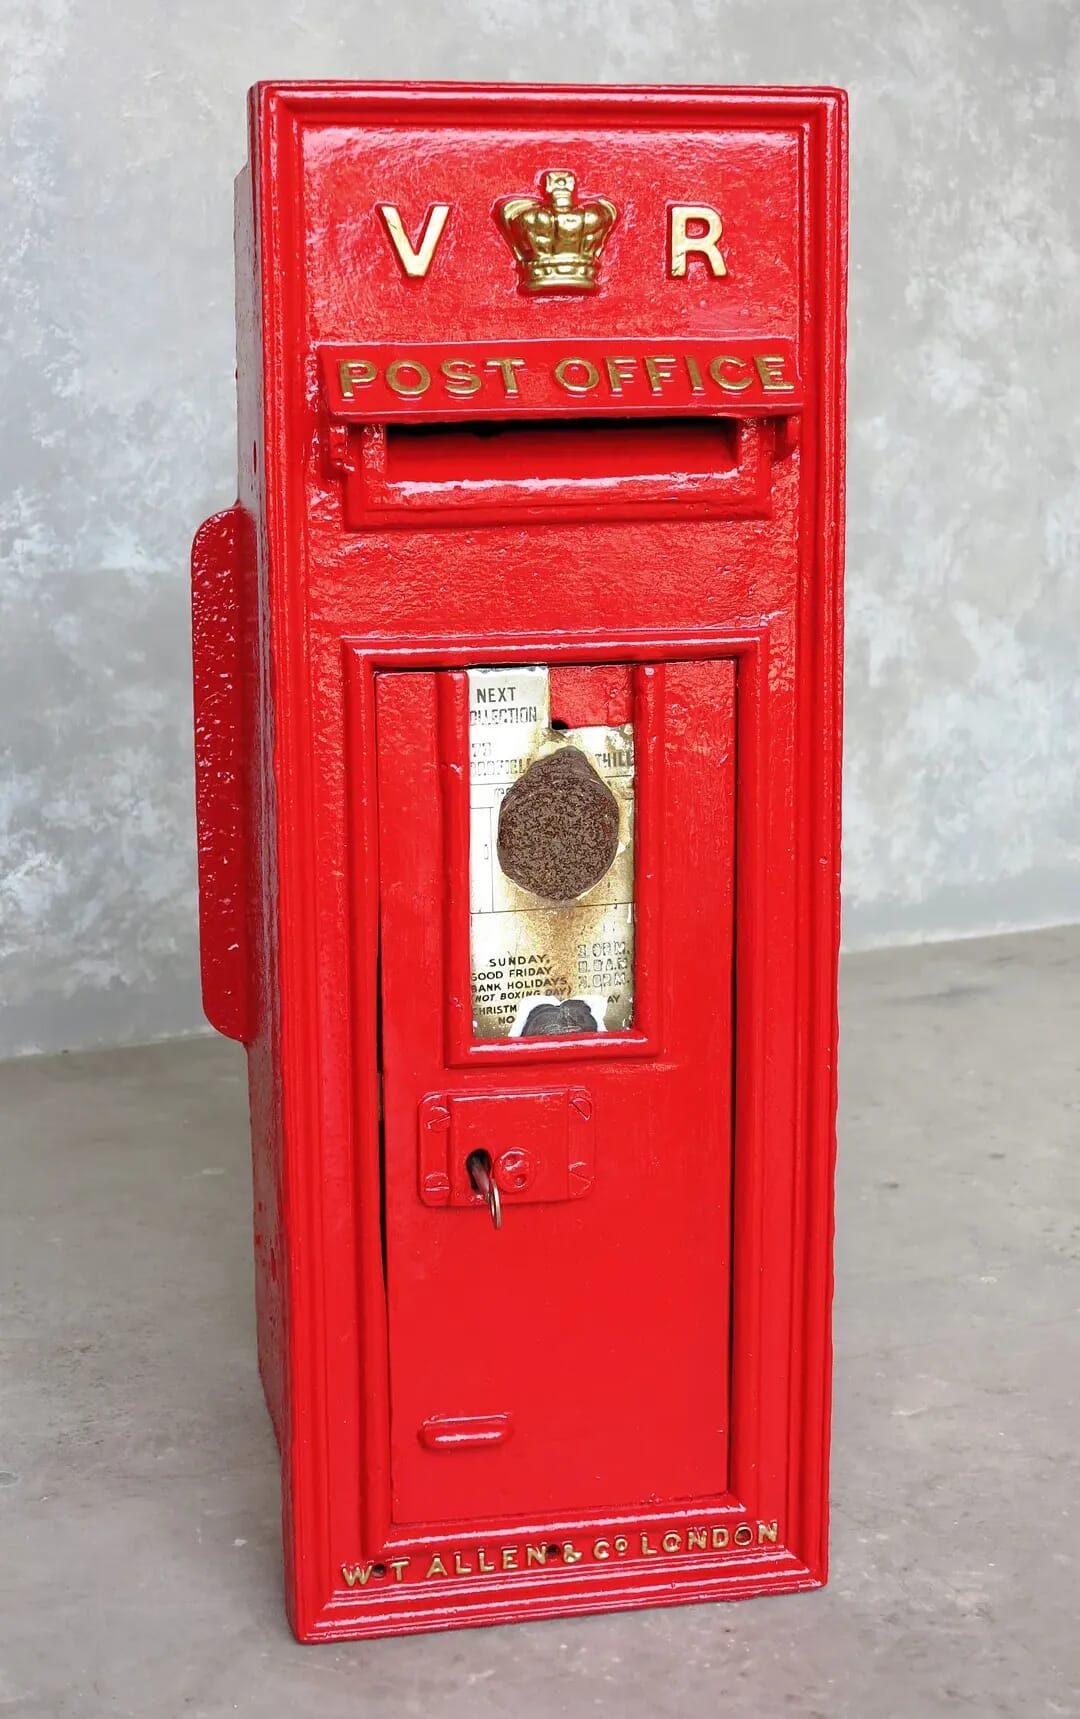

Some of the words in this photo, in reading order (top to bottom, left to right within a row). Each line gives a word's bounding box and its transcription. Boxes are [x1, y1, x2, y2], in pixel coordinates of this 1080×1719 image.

[380, 204, 450, 278] V
[670, 205, 728, 278] R
[338, 356, 525, 397] POST
[554, 355, 795, 392] OFFICE
[477, 686, 517, 703] NEXT
[489, 954, 551, 967] SUNDAY,
[471, 971, 504, 982] GOOD
[509, 966, 552, 978] FRIDAY
[471, 983, 502, 993] BANK
[507, 977, 568, 990] HOLIDAYS
[426, 1544, 548, 1579] ALLEN
[562, 1542, 583, 1564] &
[641, 1522, 779, 1556] LONDON
